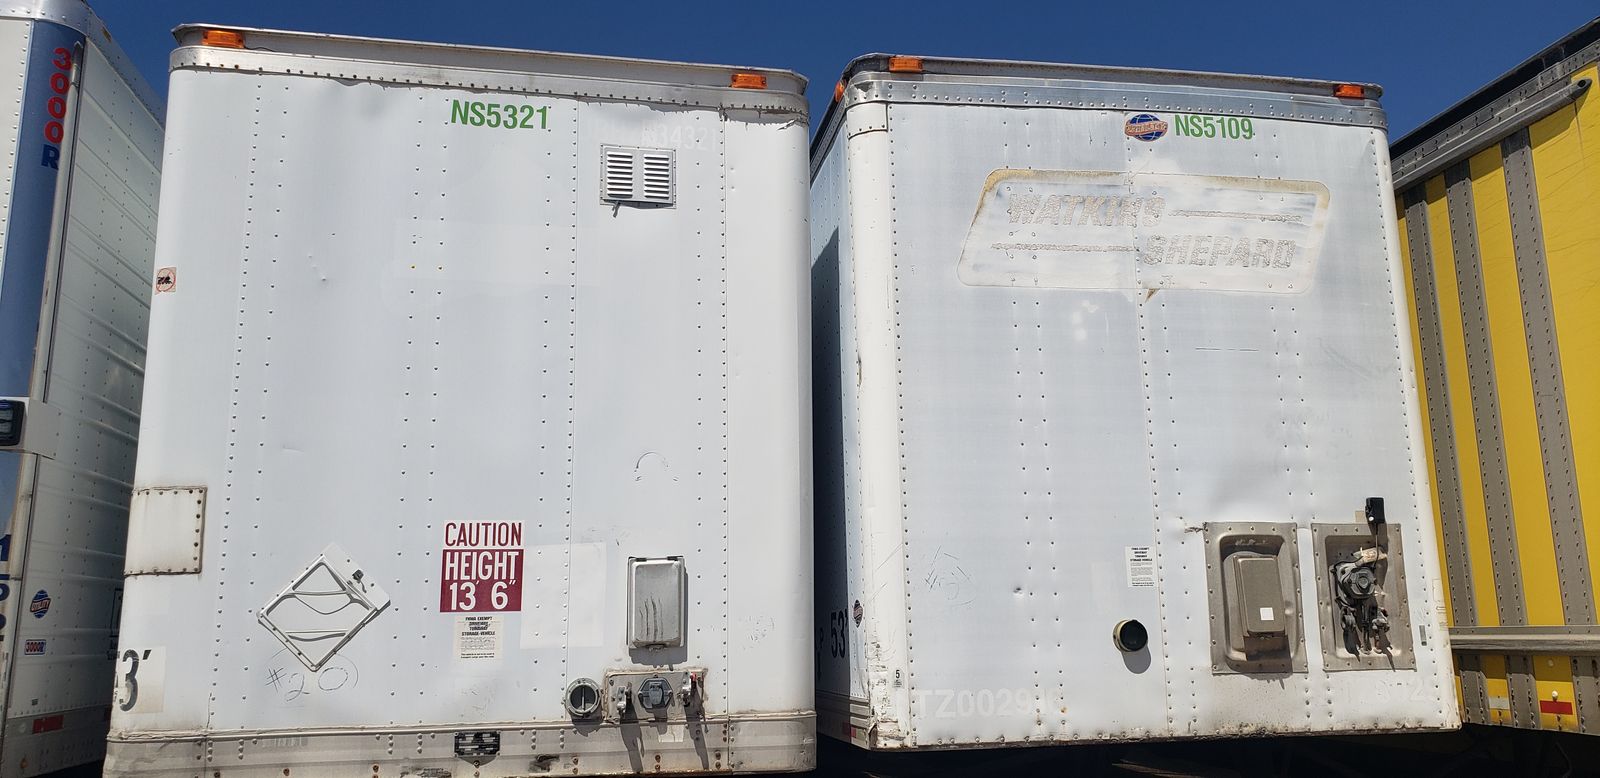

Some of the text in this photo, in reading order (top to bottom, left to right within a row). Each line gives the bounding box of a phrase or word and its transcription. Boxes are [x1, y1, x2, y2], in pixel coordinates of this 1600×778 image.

[41, 47, 73, 170] 3000R
[450, 99, 549, 130] NS5321
[1174, 114, 1253, 140] NS5109
[1008, 193, 1167, 227] WATKINS
[1144, 234, 1297, 269] SHEPARD
[445, 522, 522, 547] CAUTION
[444, 551, 520, 581] HEIGHT
[449, 579, 517, 611] 13' 6"
